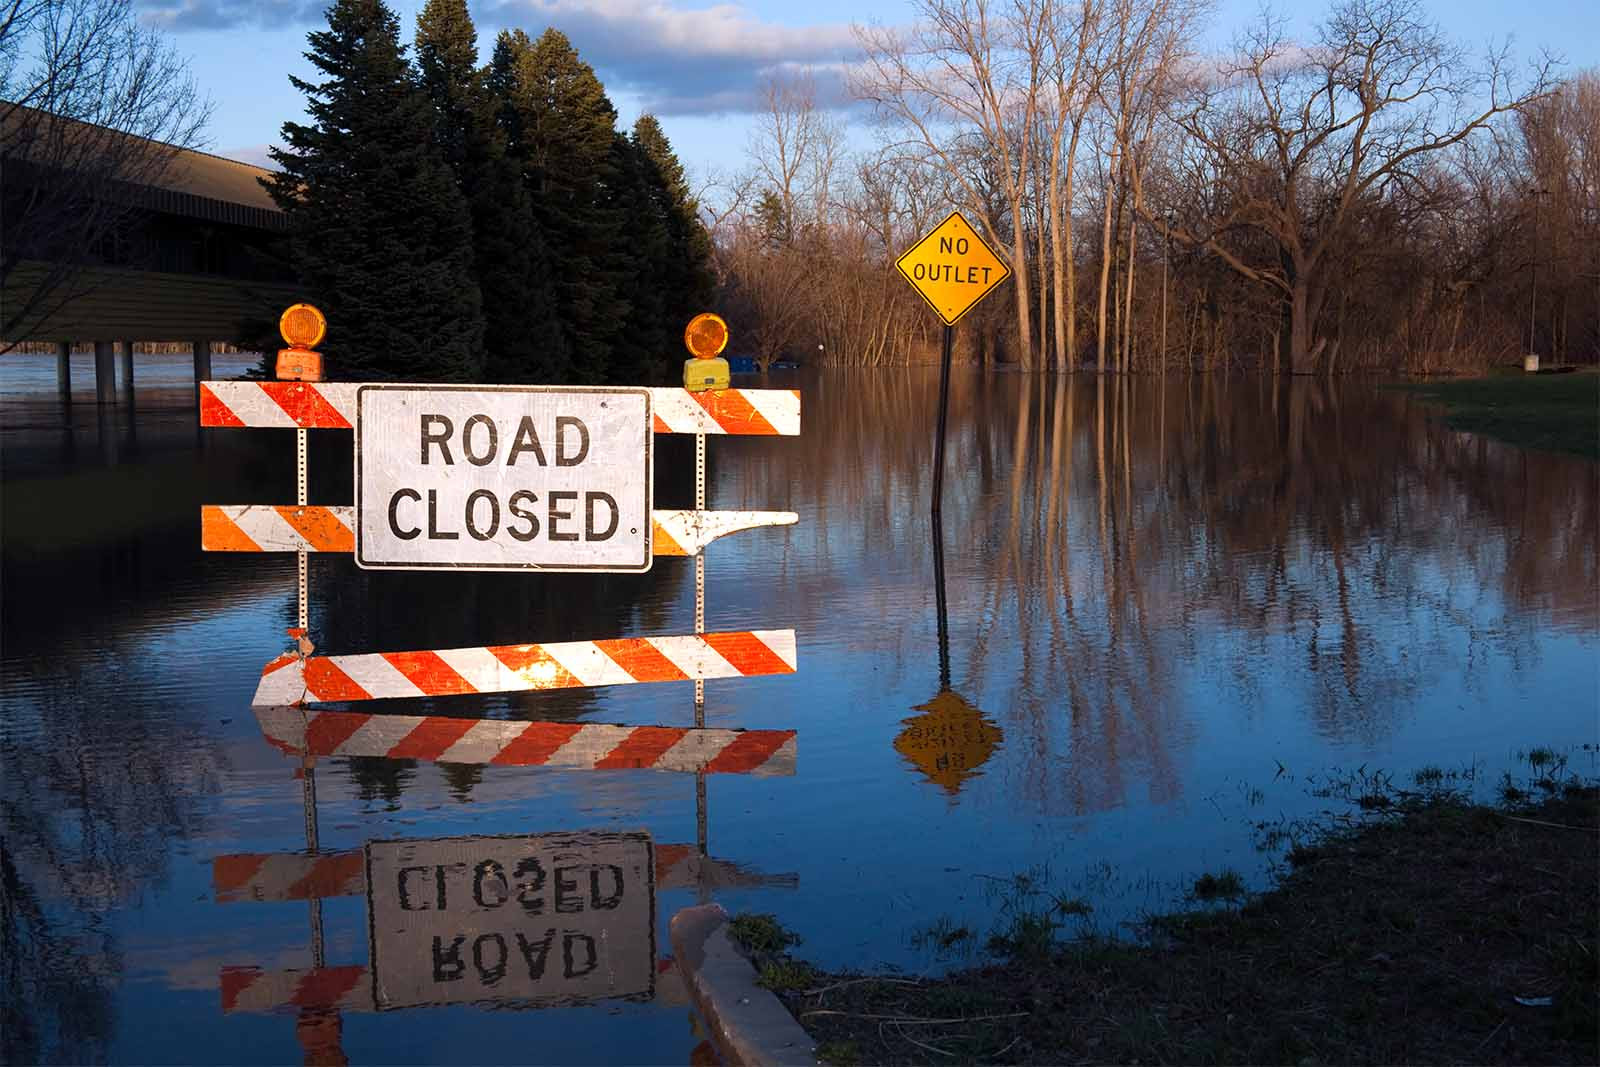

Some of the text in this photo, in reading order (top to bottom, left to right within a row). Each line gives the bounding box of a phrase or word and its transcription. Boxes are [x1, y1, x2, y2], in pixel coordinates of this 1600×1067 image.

[940, 237, 969, 255] NO
[913, 263, 992, 284] OUTLET
[421, 414, 590, 467] ROAD
[387, 488, 620, 541] CLOSED
